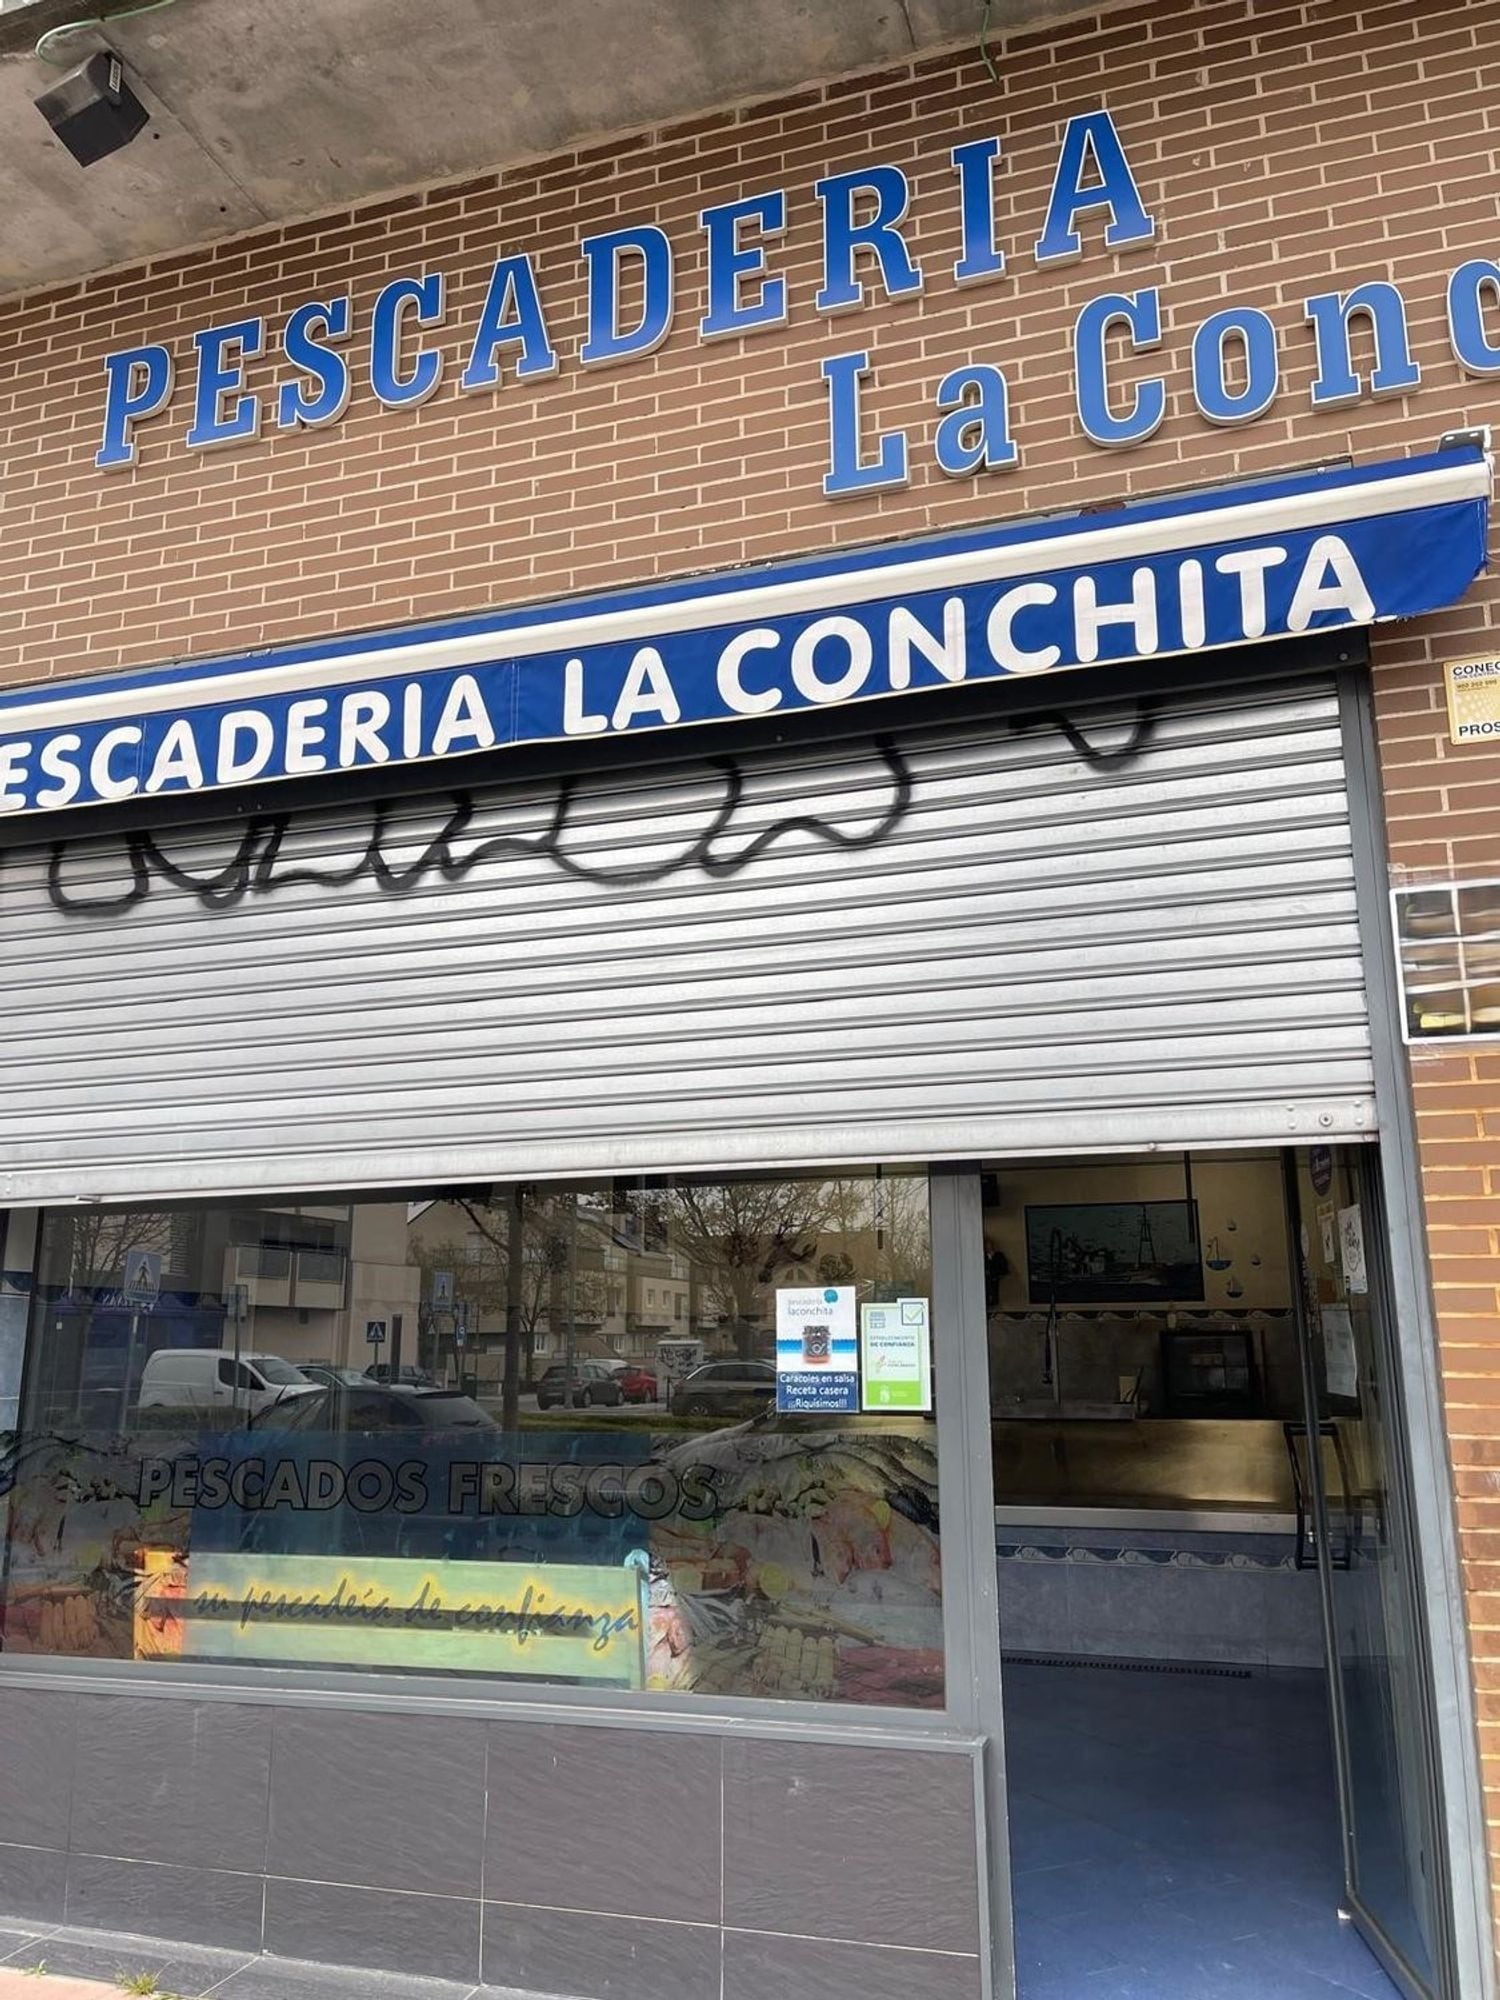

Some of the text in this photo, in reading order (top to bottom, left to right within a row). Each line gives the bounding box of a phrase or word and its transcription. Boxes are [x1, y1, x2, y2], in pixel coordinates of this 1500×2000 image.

[95, 110, 1155, 472] PESCADERIA
[821, 350, 1018, 499] La
[0, 674, 496, 813] ESCADERIA
[563, 647, 681, 736] LA
[716, 534, 1377, 714] CONCHITA
[780, 1373, 855, 1383] Caracoles en salsa
[785, 1385, 849, 1395] Receta casera
[137, 1458, 719, 1521] PESCADOS FRESCOS
[404, 1580, 442, 1623] de
[454, 1585, 639, 1651] confianza
